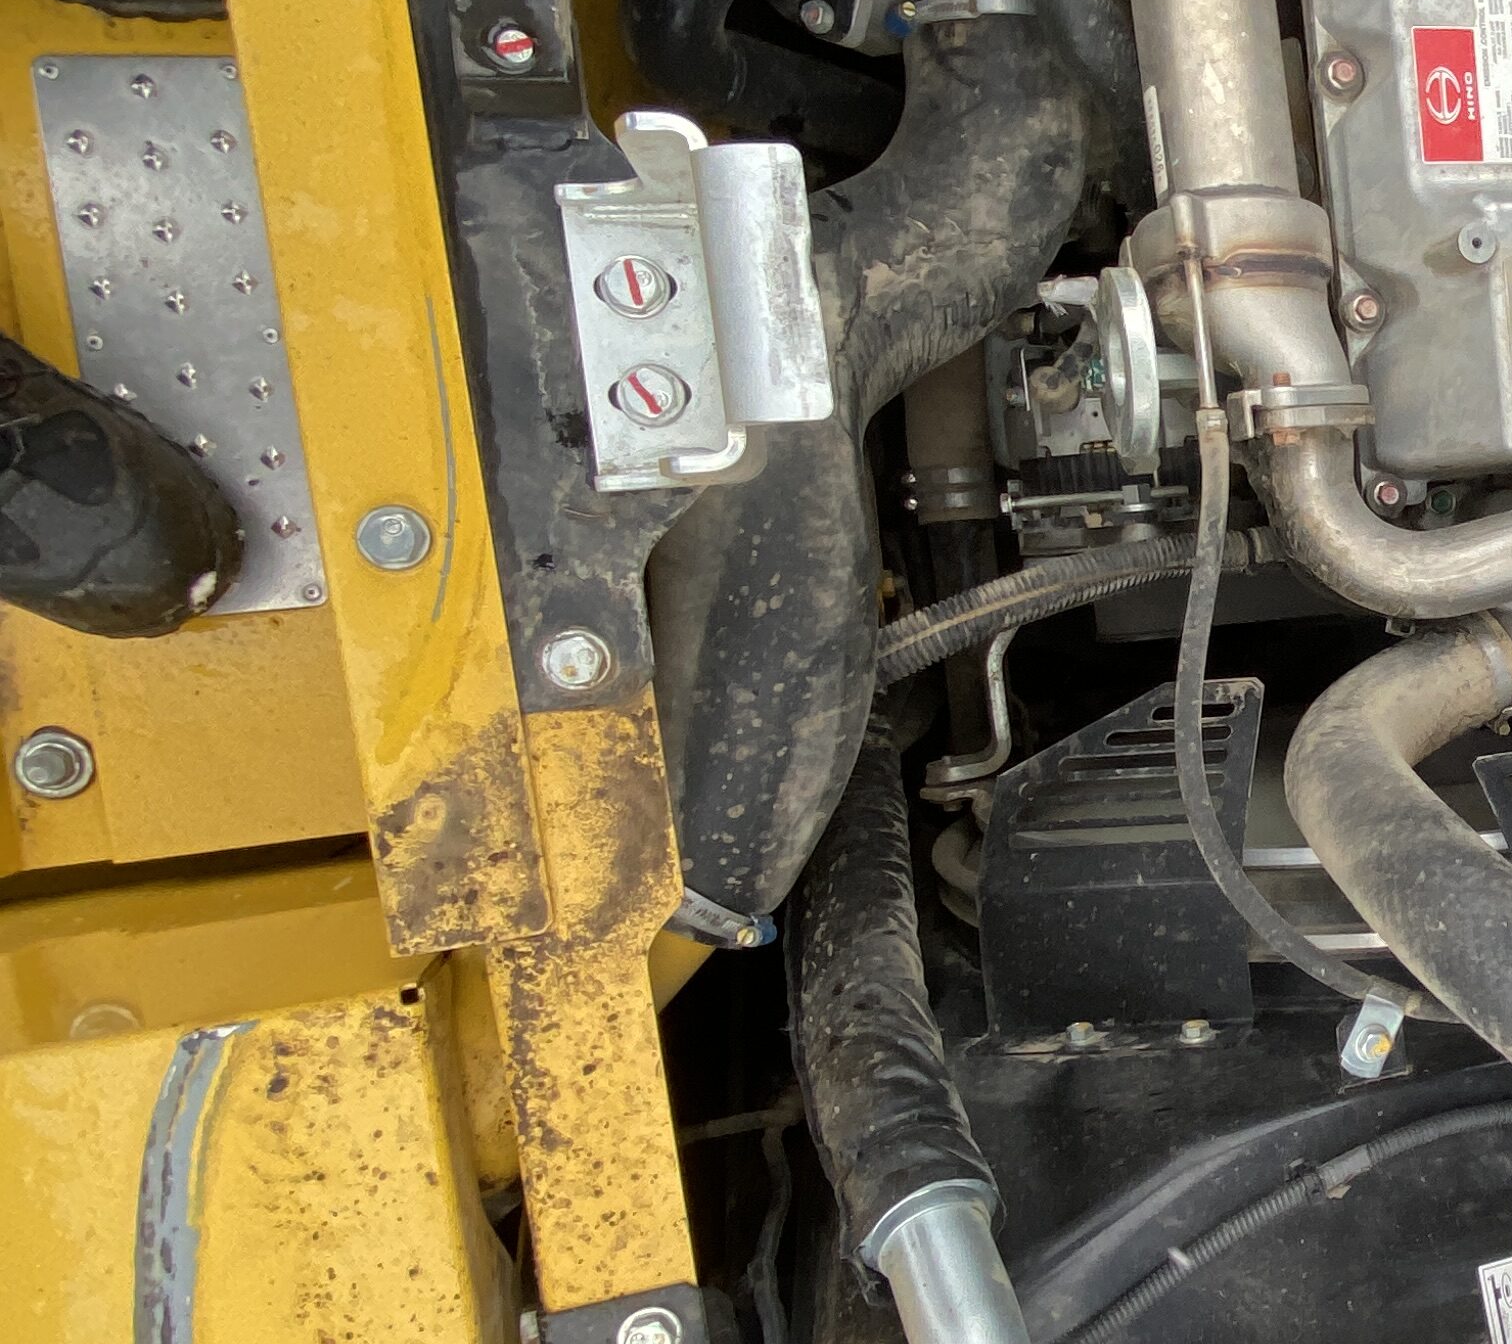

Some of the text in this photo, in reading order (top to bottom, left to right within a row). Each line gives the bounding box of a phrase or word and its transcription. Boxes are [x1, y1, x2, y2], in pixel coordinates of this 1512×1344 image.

[1478, 8, 1488, 45] CONTROL
[1481, 48, 1491, 87] EMISSION
[1464, 72, 1476, 120] HINO
